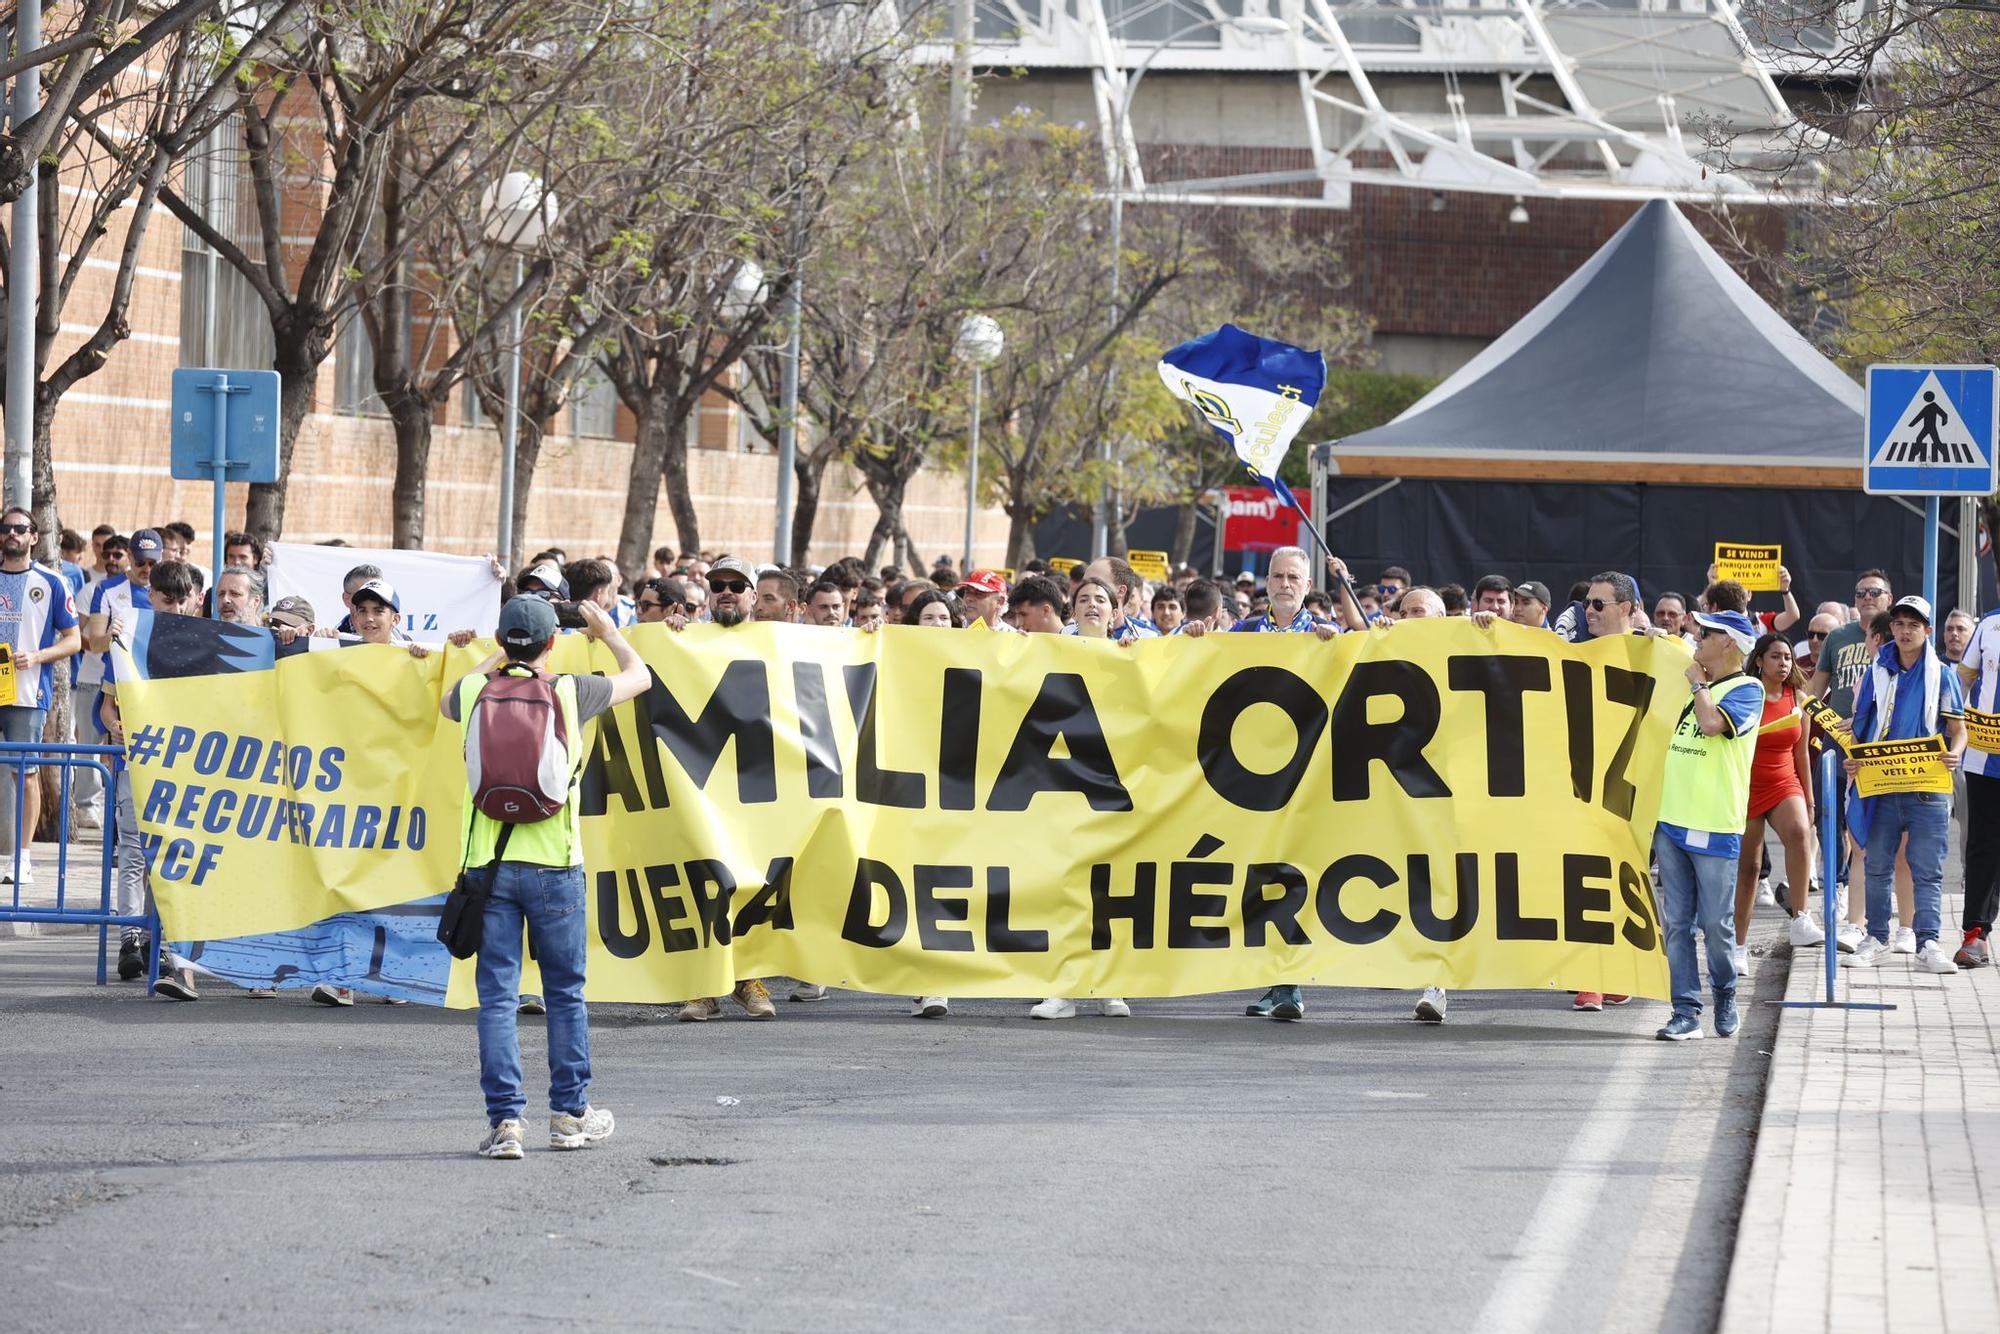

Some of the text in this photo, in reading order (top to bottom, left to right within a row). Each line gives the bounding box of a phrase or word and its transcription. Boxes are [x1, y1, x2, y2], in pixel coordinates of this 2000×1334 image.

[1719, 561, 1776, 570] ENRIQUE ORTIZ
[1726, 549, 1770, 559] SE VENDE
[128, 724, 346, 792] #PODEOS
[576, 655, 1656, 821] AMILIA ORTIZ
[1864, 743, 1928, 757] SE VENDE
[1882, 766, 1926, 776] VETE YA
[142, 779, 427, 851] RECUPERARLO
[584, 856, 795, 959] UERA
[841, 857, 1049, 953] DEL
